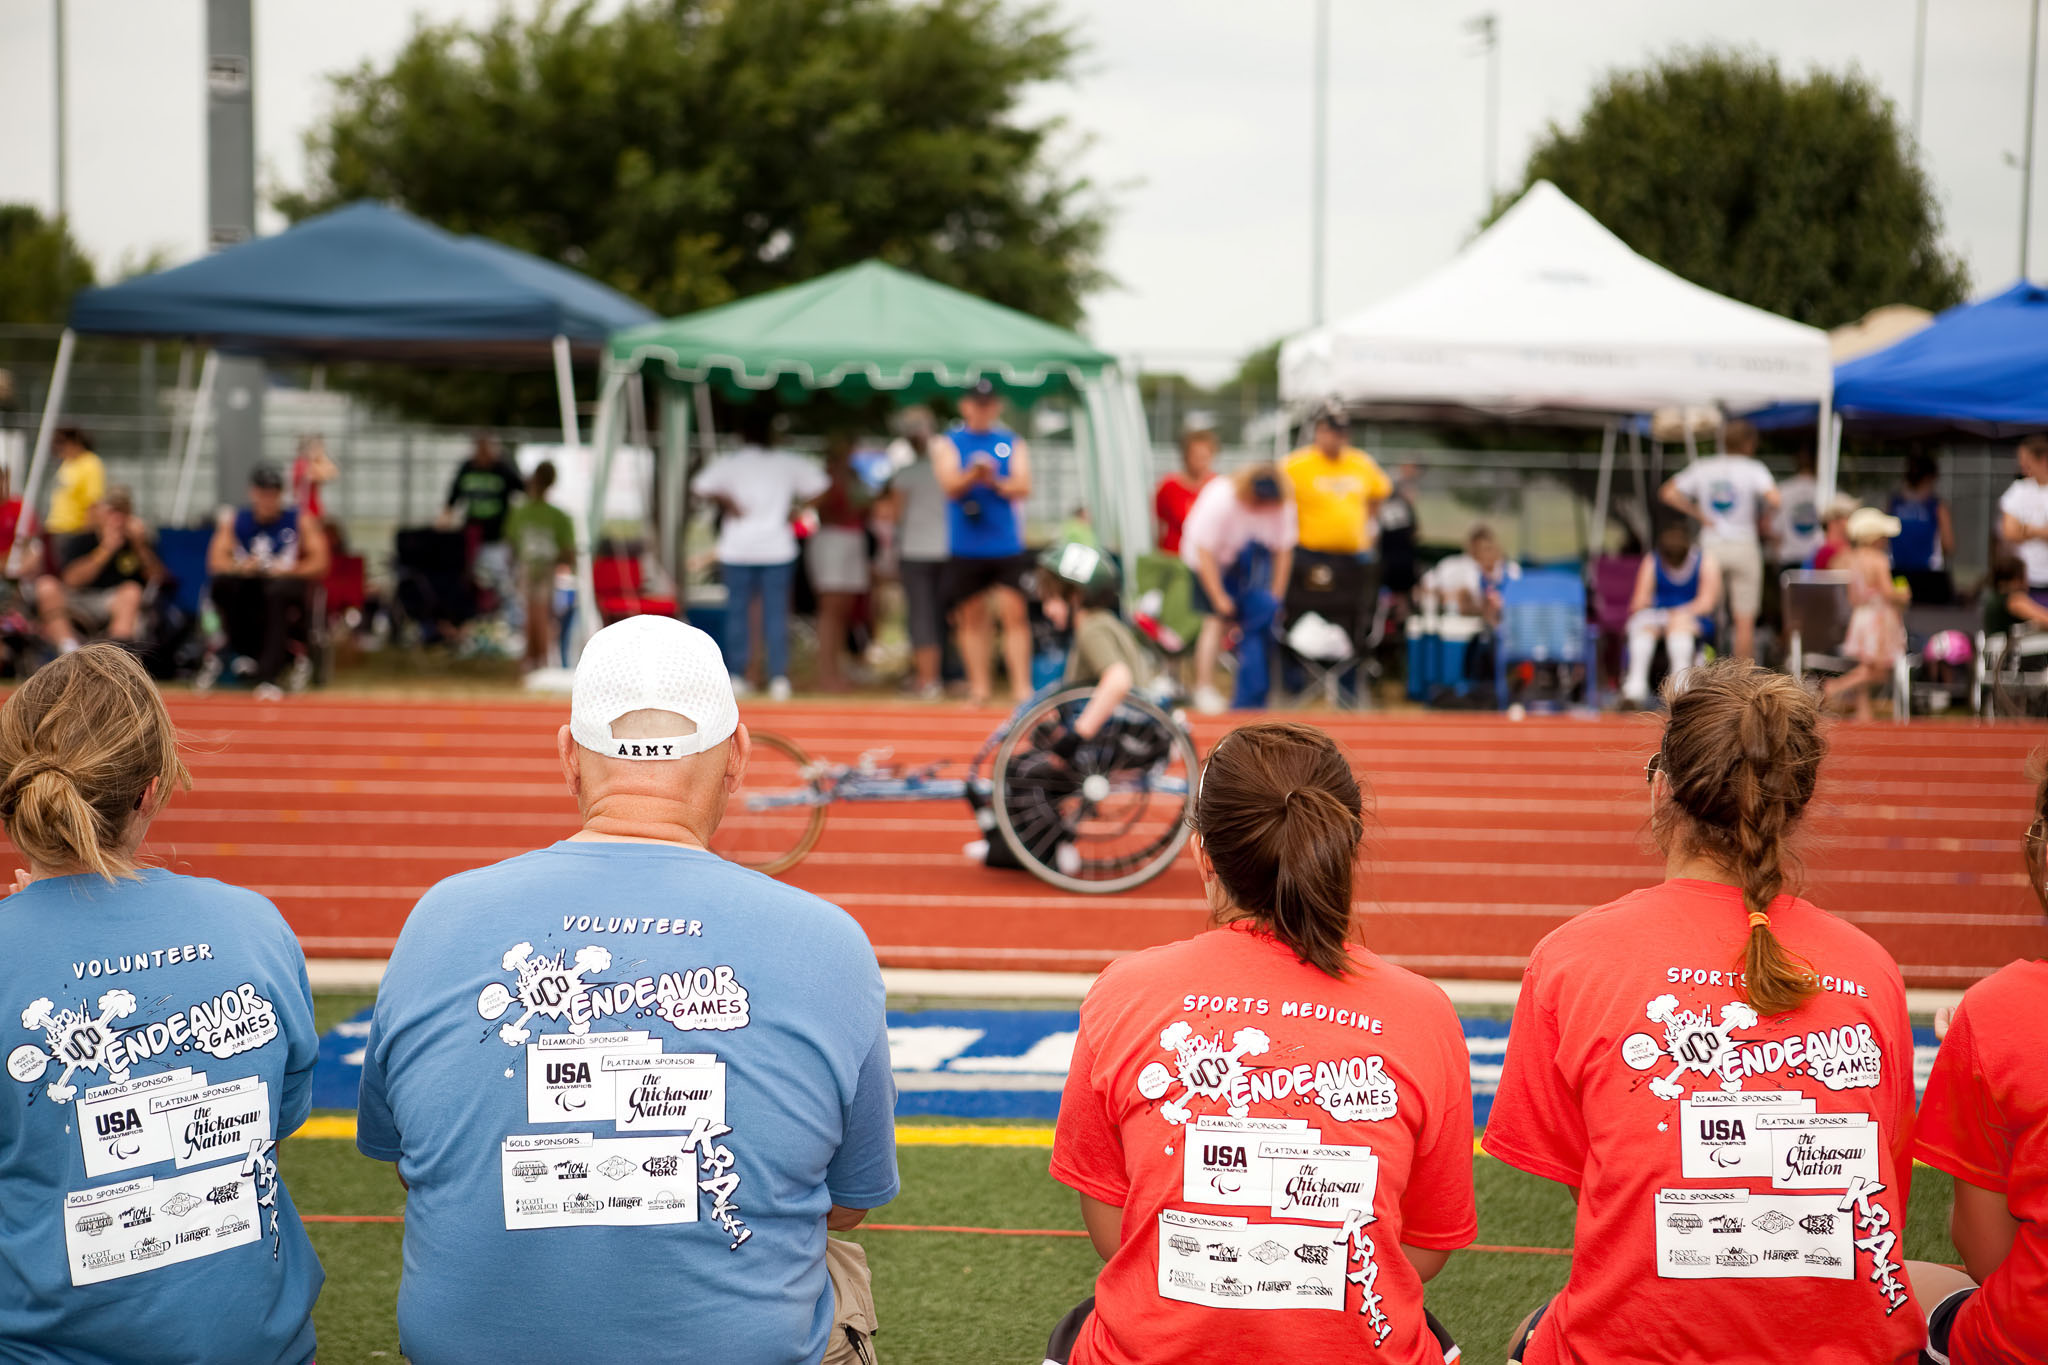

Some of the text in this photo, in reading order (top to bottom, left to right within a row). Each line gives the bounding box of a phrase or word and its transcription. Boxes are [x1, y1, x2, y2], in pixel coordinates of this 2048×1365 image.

[617, 743, 674, 757] ARMY
[562, 914, 704, 937] VOLUNTEER
[72, 943, 214, 980] VOLUNTEER
[529, 975, 570, 1006] UCO
[569, 965, 739, 1025] ENDEAVOR
[672, 999, 742, 1018] GAMES
[1183, 994, 1383, 1034] SPORTS MEDICINE
[104, 982, 264, 1073] ENDEAVOR
[209, 1013, 270, 1048] GAMES
[64, 1027, 102, 1061] UCO
[542, 1035, 629, 1046] DIAMOND SPONSOR
[1680, 1032, 1720, 1063] UCO
[1722, 1023, 1877, 1082] ENDEAVOR
[19, 1056, 37, 1069] TITLE
[606, 1058, 696, 1067] PLATINUM SPONSOR
[1823, 1056, 1878, 1078] GAMES
[546, 1062, 592, 1084] USA
[642, 1073, 661, 1086] the
[1189, 1057, 1230, 1088] UCO
[1229, 1055, 1388, 1108] ENDEAVOR
[87, 1084, 128, 1101] DIAMOND
[628, 1086, 713, 1108] Chickasaw
[1329, 1089, 1392, 1108] GAMES
[1695, 1094, 1783, 1104] DIAMOND SPONSOR
[155, 1094, 200, 1109] PLATINUM
[193, 1106, 213, 1121] the
[625, 1102, 687, 1123] Nation
[95, 1107, 143, 1137] USA
[184, 1109, 261, 1144] Chickasaw
[1200, 1119, 1288, 1130] DIAMOND SPONSOR
[1700, 1119, 1746, 1140] USA
[1761, 1118, 1805, 1126] PLATINUM
[98, 1128, 144, 1142] PARALYMPICS
[509, 1138, 531, 1147] GOLD
[1797, 1133, 1816, 1145] the
[182, 1129, 242, 1160] Nation
[1264, 1147, 1351, 1157] PLATINUM SPONSOR
[1203, 1144, 1248, 1168] USA
[1786, 1146, 1866, 1168] Chickasaw
[568, 1162, 589, 1174] 104.1
[650, 1160, 678, 1169] 1520
[650, 1168, 678, 1177] KOKC
[1299, 1164, 1318, 1176] the
[1781, 1161, 1842, 1181] Nation
[681, 1117, 752, 1251] KRAKK!
[1285, 1176, 1364, 1197] Chickasaw
[70, 1194, 93, 1204] GOLD
[213, 1192, 239, 1205] KOKC
[608, 1196, 642, 1209] Hanger
[1280, 1193, 1339, 1210] Nation
[1664, 1191, 1686, 1200] GOLD
[132, 1206, 152, 1221] 104.1
[521, 1203, 558, 1211] SABOLICH
[563, 1200, 605, 1212] EDMOND
[1166, 1213, 1186, 1223] GOLD
[1807, 1219, 1834, 1229] 1520
[175, 1227, 210, 1245] Hanger
[1807, 1227, 1834, 1235] KOKC
[87, 1249, 111, 1260] SCOTT
[130, 1240, 171, 1260] EDMOND
[1837, 1176, 1908, 1317] KRAKK!
[87, 1252, 126, 1266] SABOLICH
[1715, 1253, 1758, 1265] EDMOND
[1763, 1250, 1799, 1262] Hanger
[1333, 1209, 1393, 1348] KRAKK!
[1211, 1282, 1252, 1294] EDMOND
